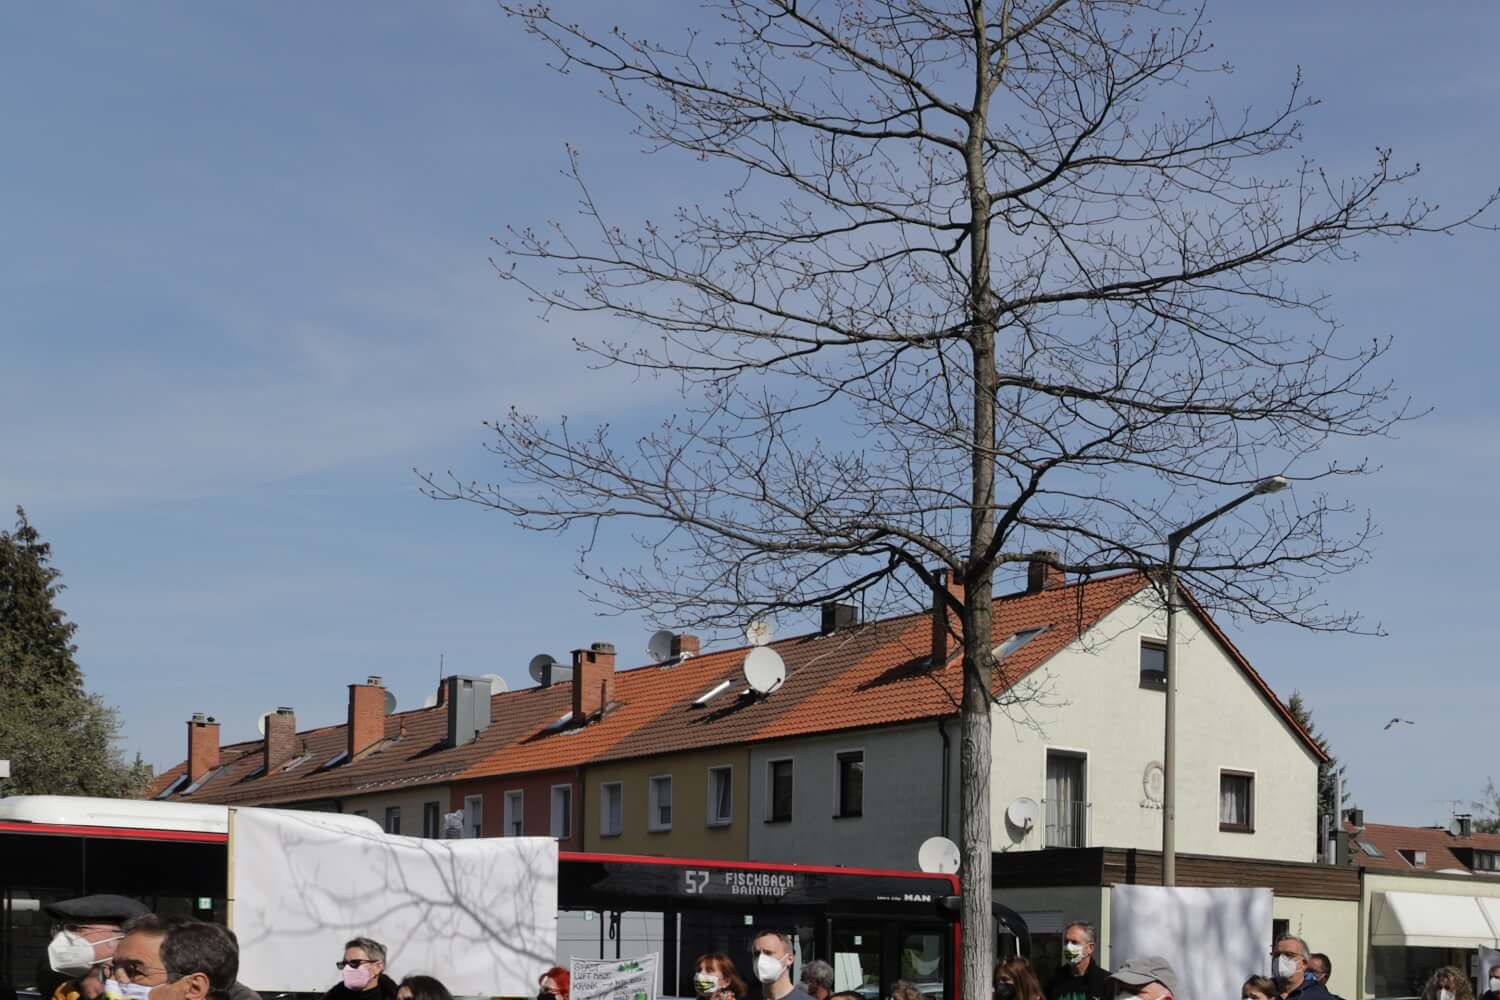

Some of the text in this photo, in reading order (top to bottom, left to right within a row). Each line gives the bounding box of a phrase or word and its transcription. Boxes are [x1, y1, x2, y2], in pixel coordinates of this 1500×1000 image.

[685, 870, 710, 893] 57
[725, 873, 794, 887] FISCHBACH
[732, 886, 788, 896] BAHNHOF
[904, 894, 931, 902] MAN
